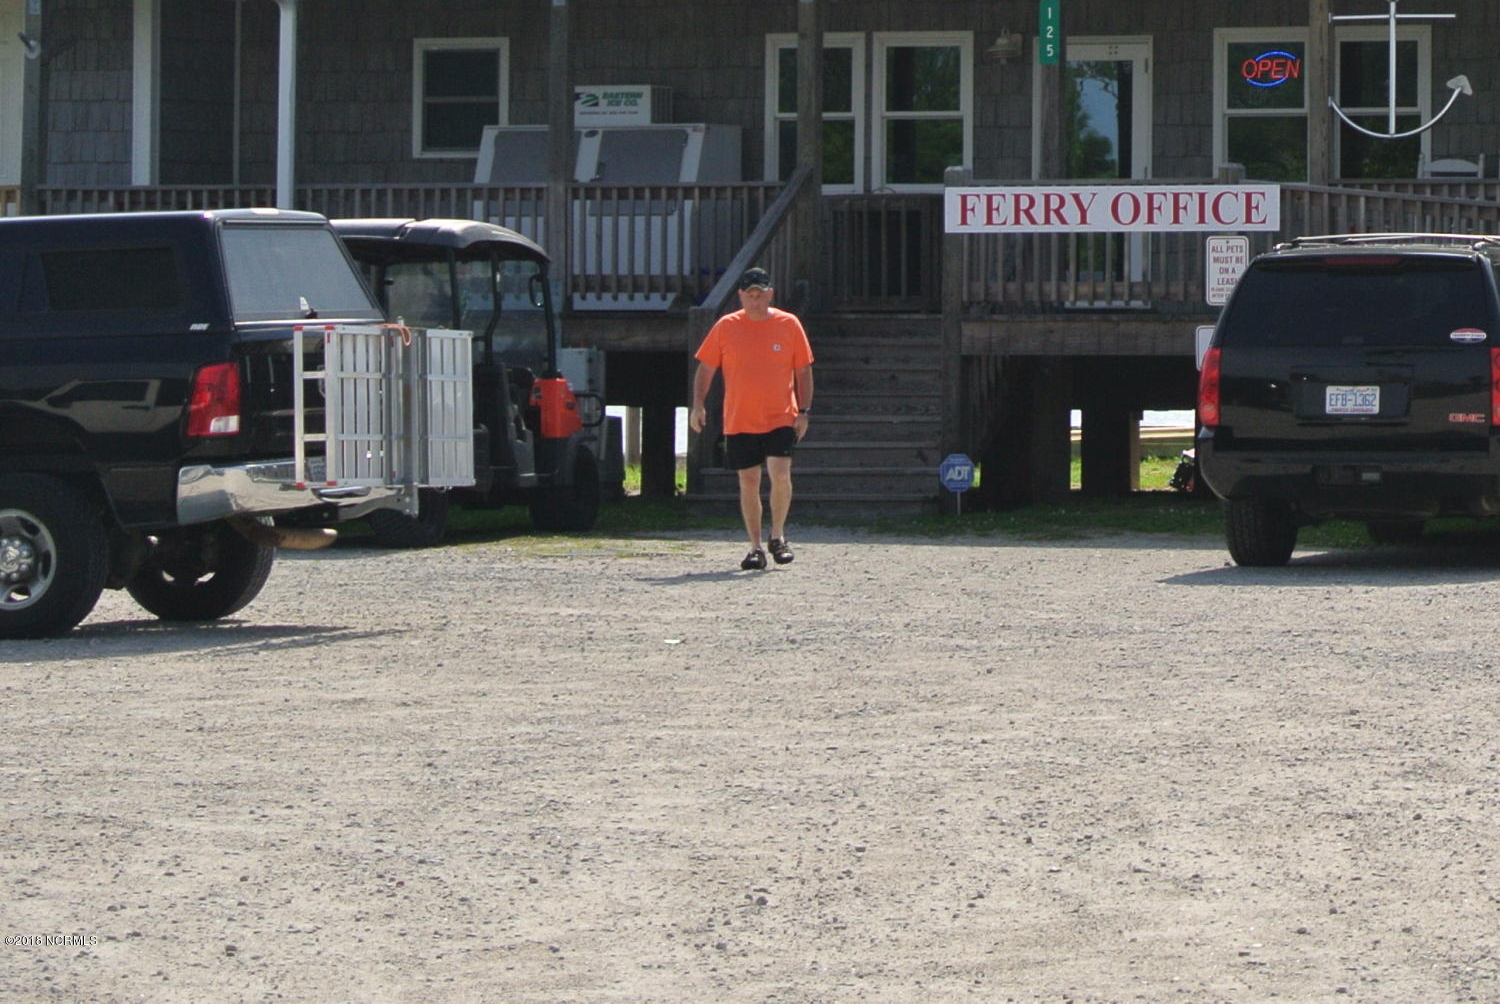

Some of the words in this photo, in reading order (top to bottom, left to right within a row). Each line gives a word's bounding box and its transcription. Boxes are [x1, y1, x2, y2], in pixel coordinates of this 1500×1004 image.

[1046, 6, 1055, 57] 125
[1241, 58, 1301, 79] OPEN
[958, 192, 1098, 226] FERRY
[1110, 191, 1268, 226] OFFICE
[1211, 244, 1223, 253] ALL
[1226, 244, 1243, 253] PETS
[1213, 256, 1233, 264] MUST
[1235, 256, 1243, 264] BE
[1448, 413, 1486, 423] GMC
[945, 466, 971, 481] ADT
